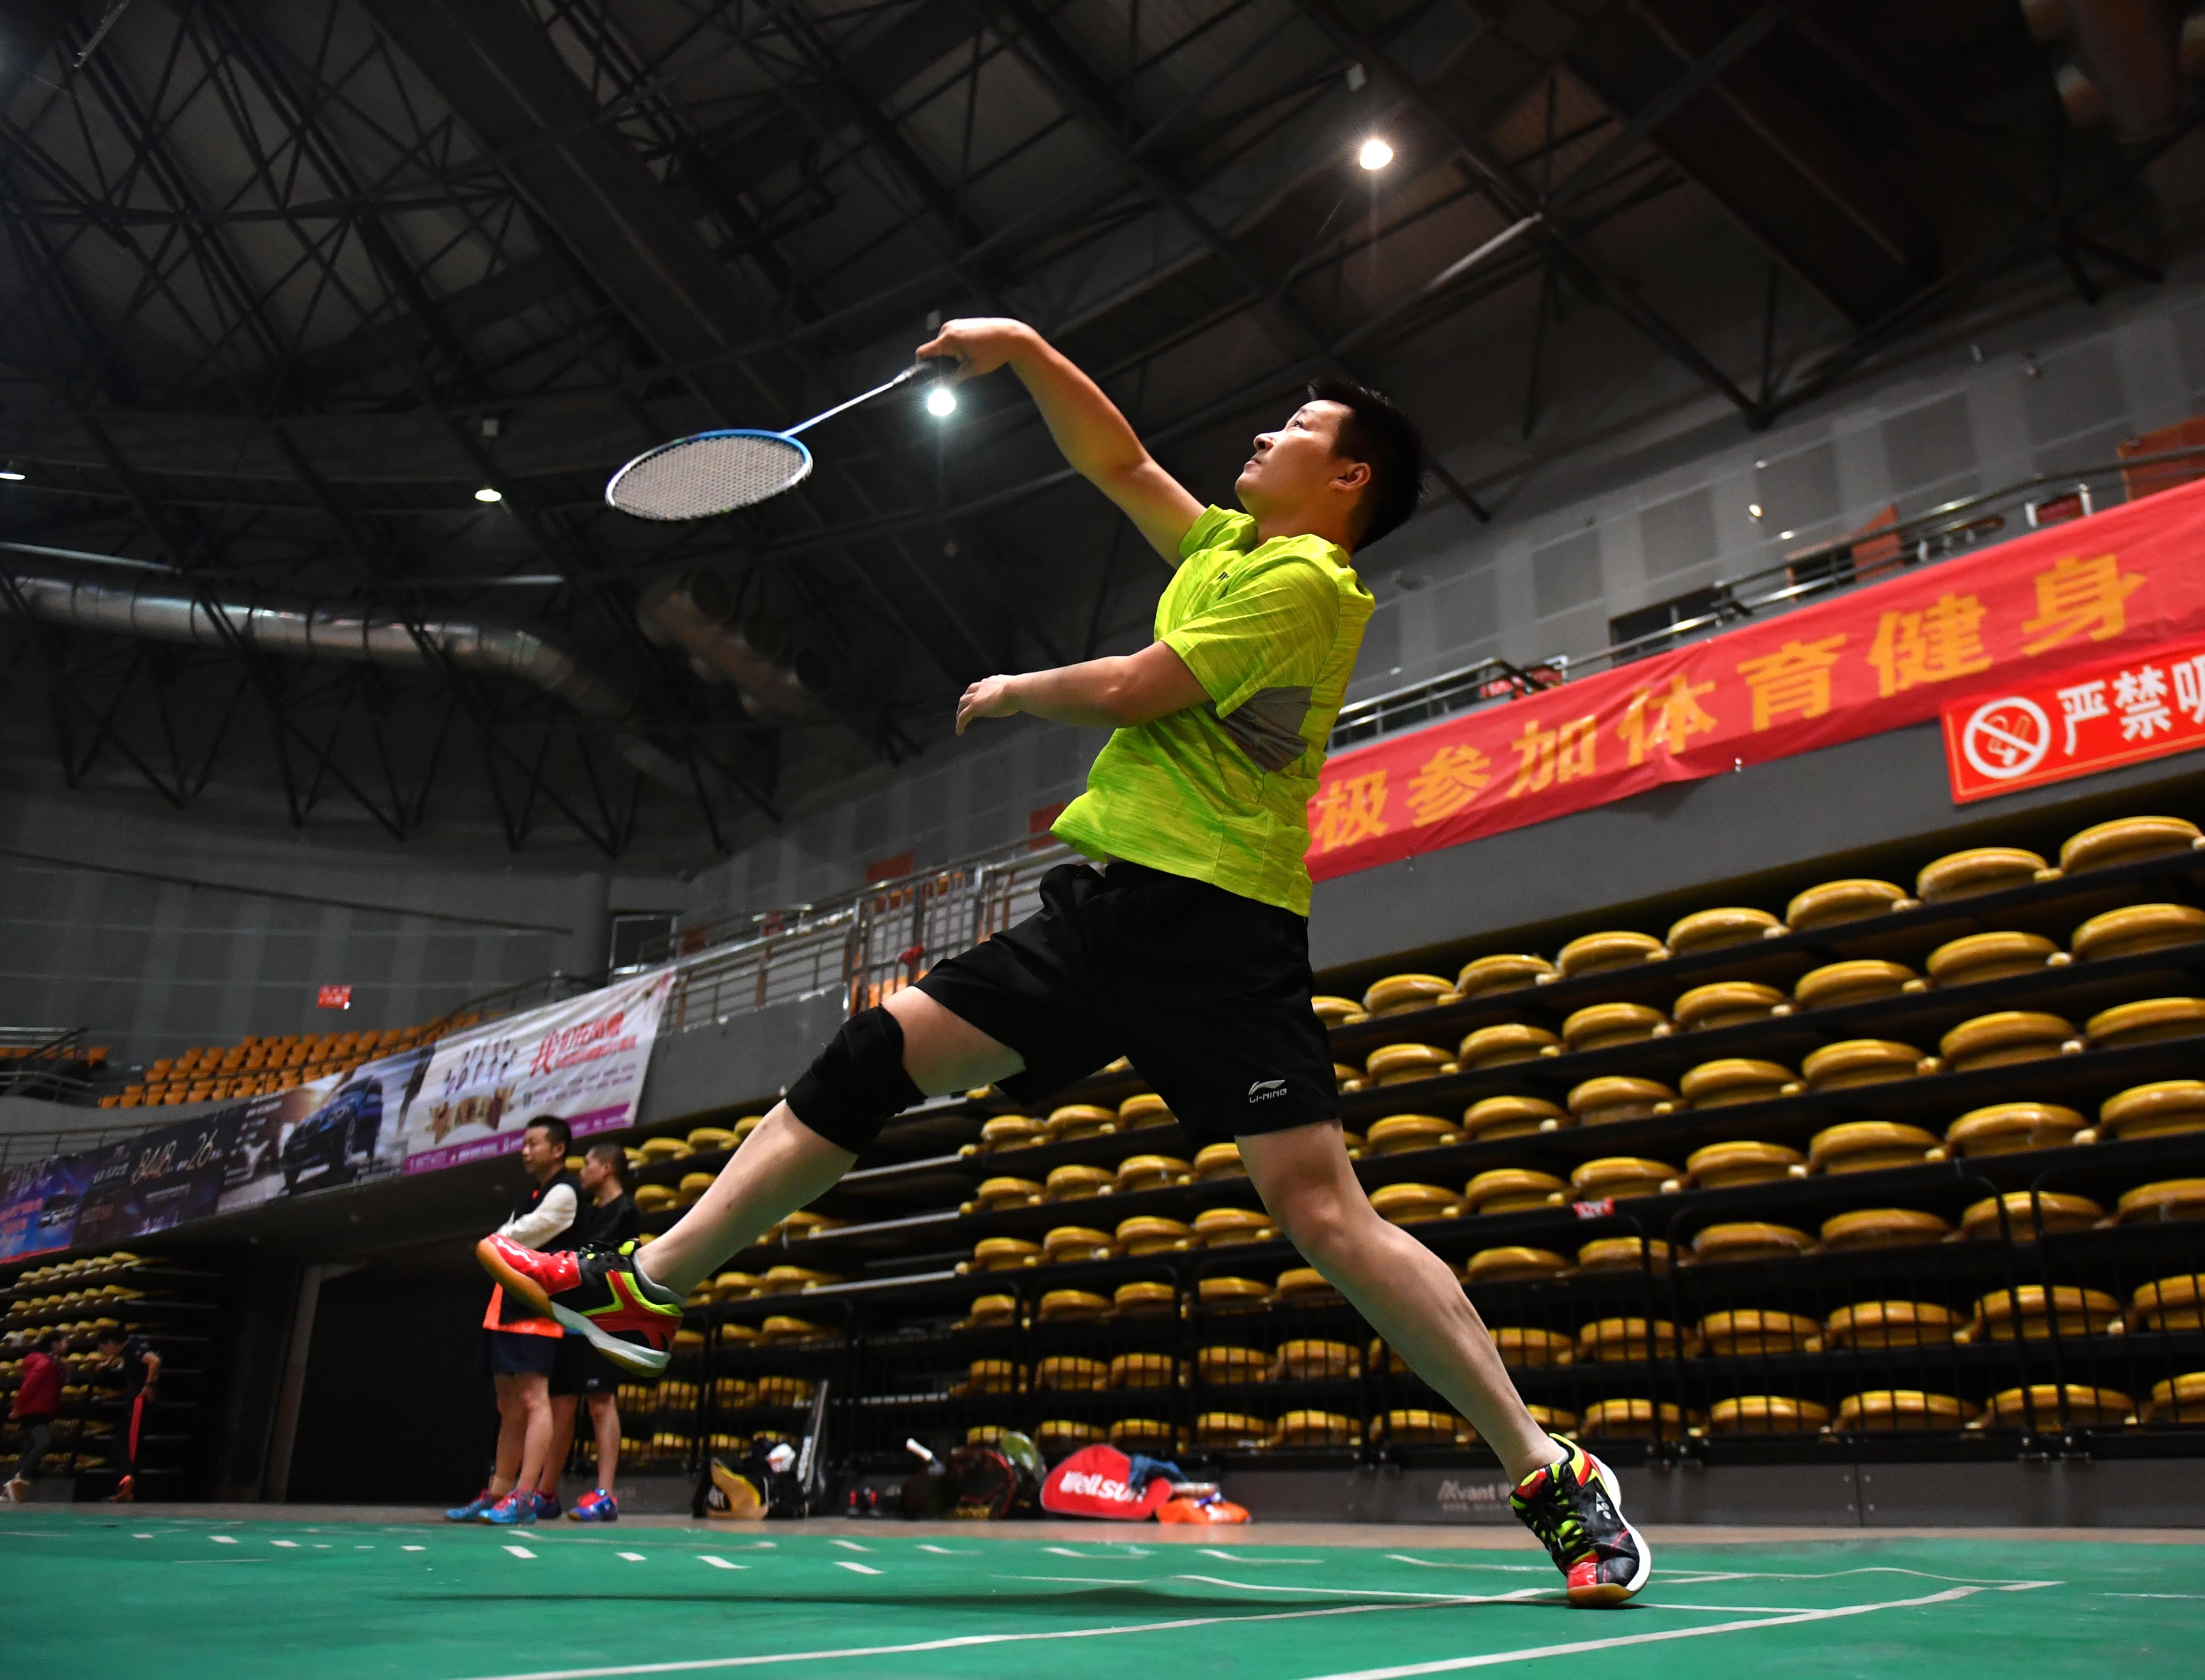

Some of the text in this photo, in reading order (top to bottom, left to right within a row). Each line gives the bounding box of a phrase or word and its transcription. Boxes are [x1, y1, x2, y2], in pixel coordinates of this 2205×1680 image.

[1313, 554, 2147, 853] 极参加体育健身
[1249, 1088, 1287, 1103] LI-NING
